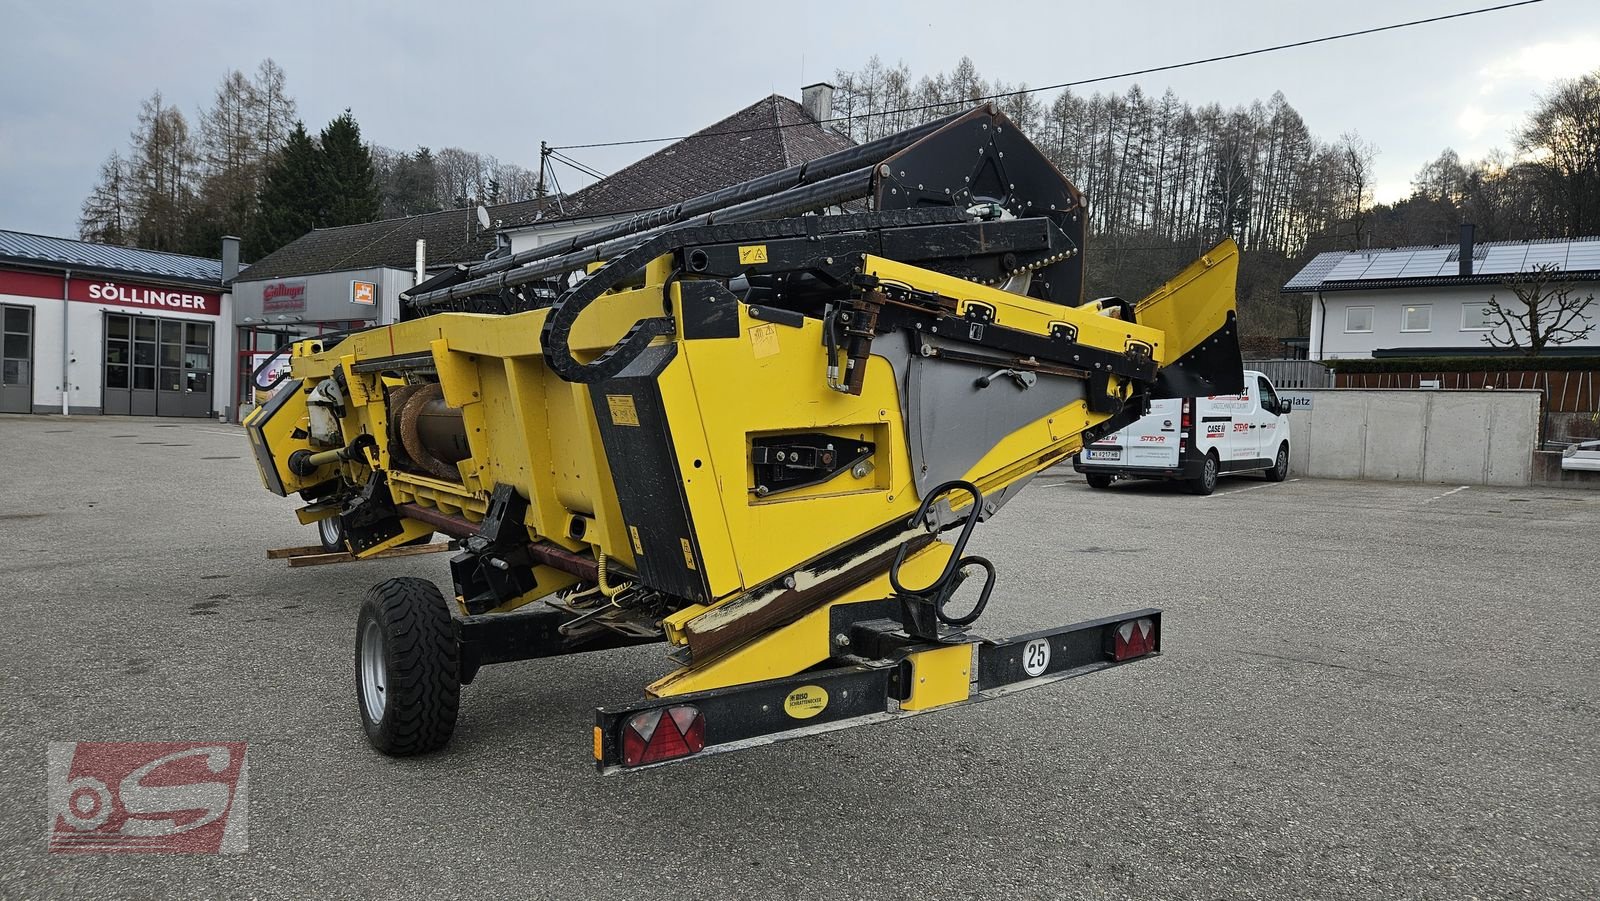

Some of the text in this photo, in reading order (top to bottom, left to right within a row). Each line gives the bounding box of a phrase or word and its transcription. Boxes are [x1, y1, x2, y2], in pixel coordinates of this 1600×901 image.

[89, 282, 206, 309] SÖLLINGER
[1207, 425, 1220, 433] CASE
[1233, 423, 1249, 432] STEYR
[1028, 643, 1045, 668] 25
